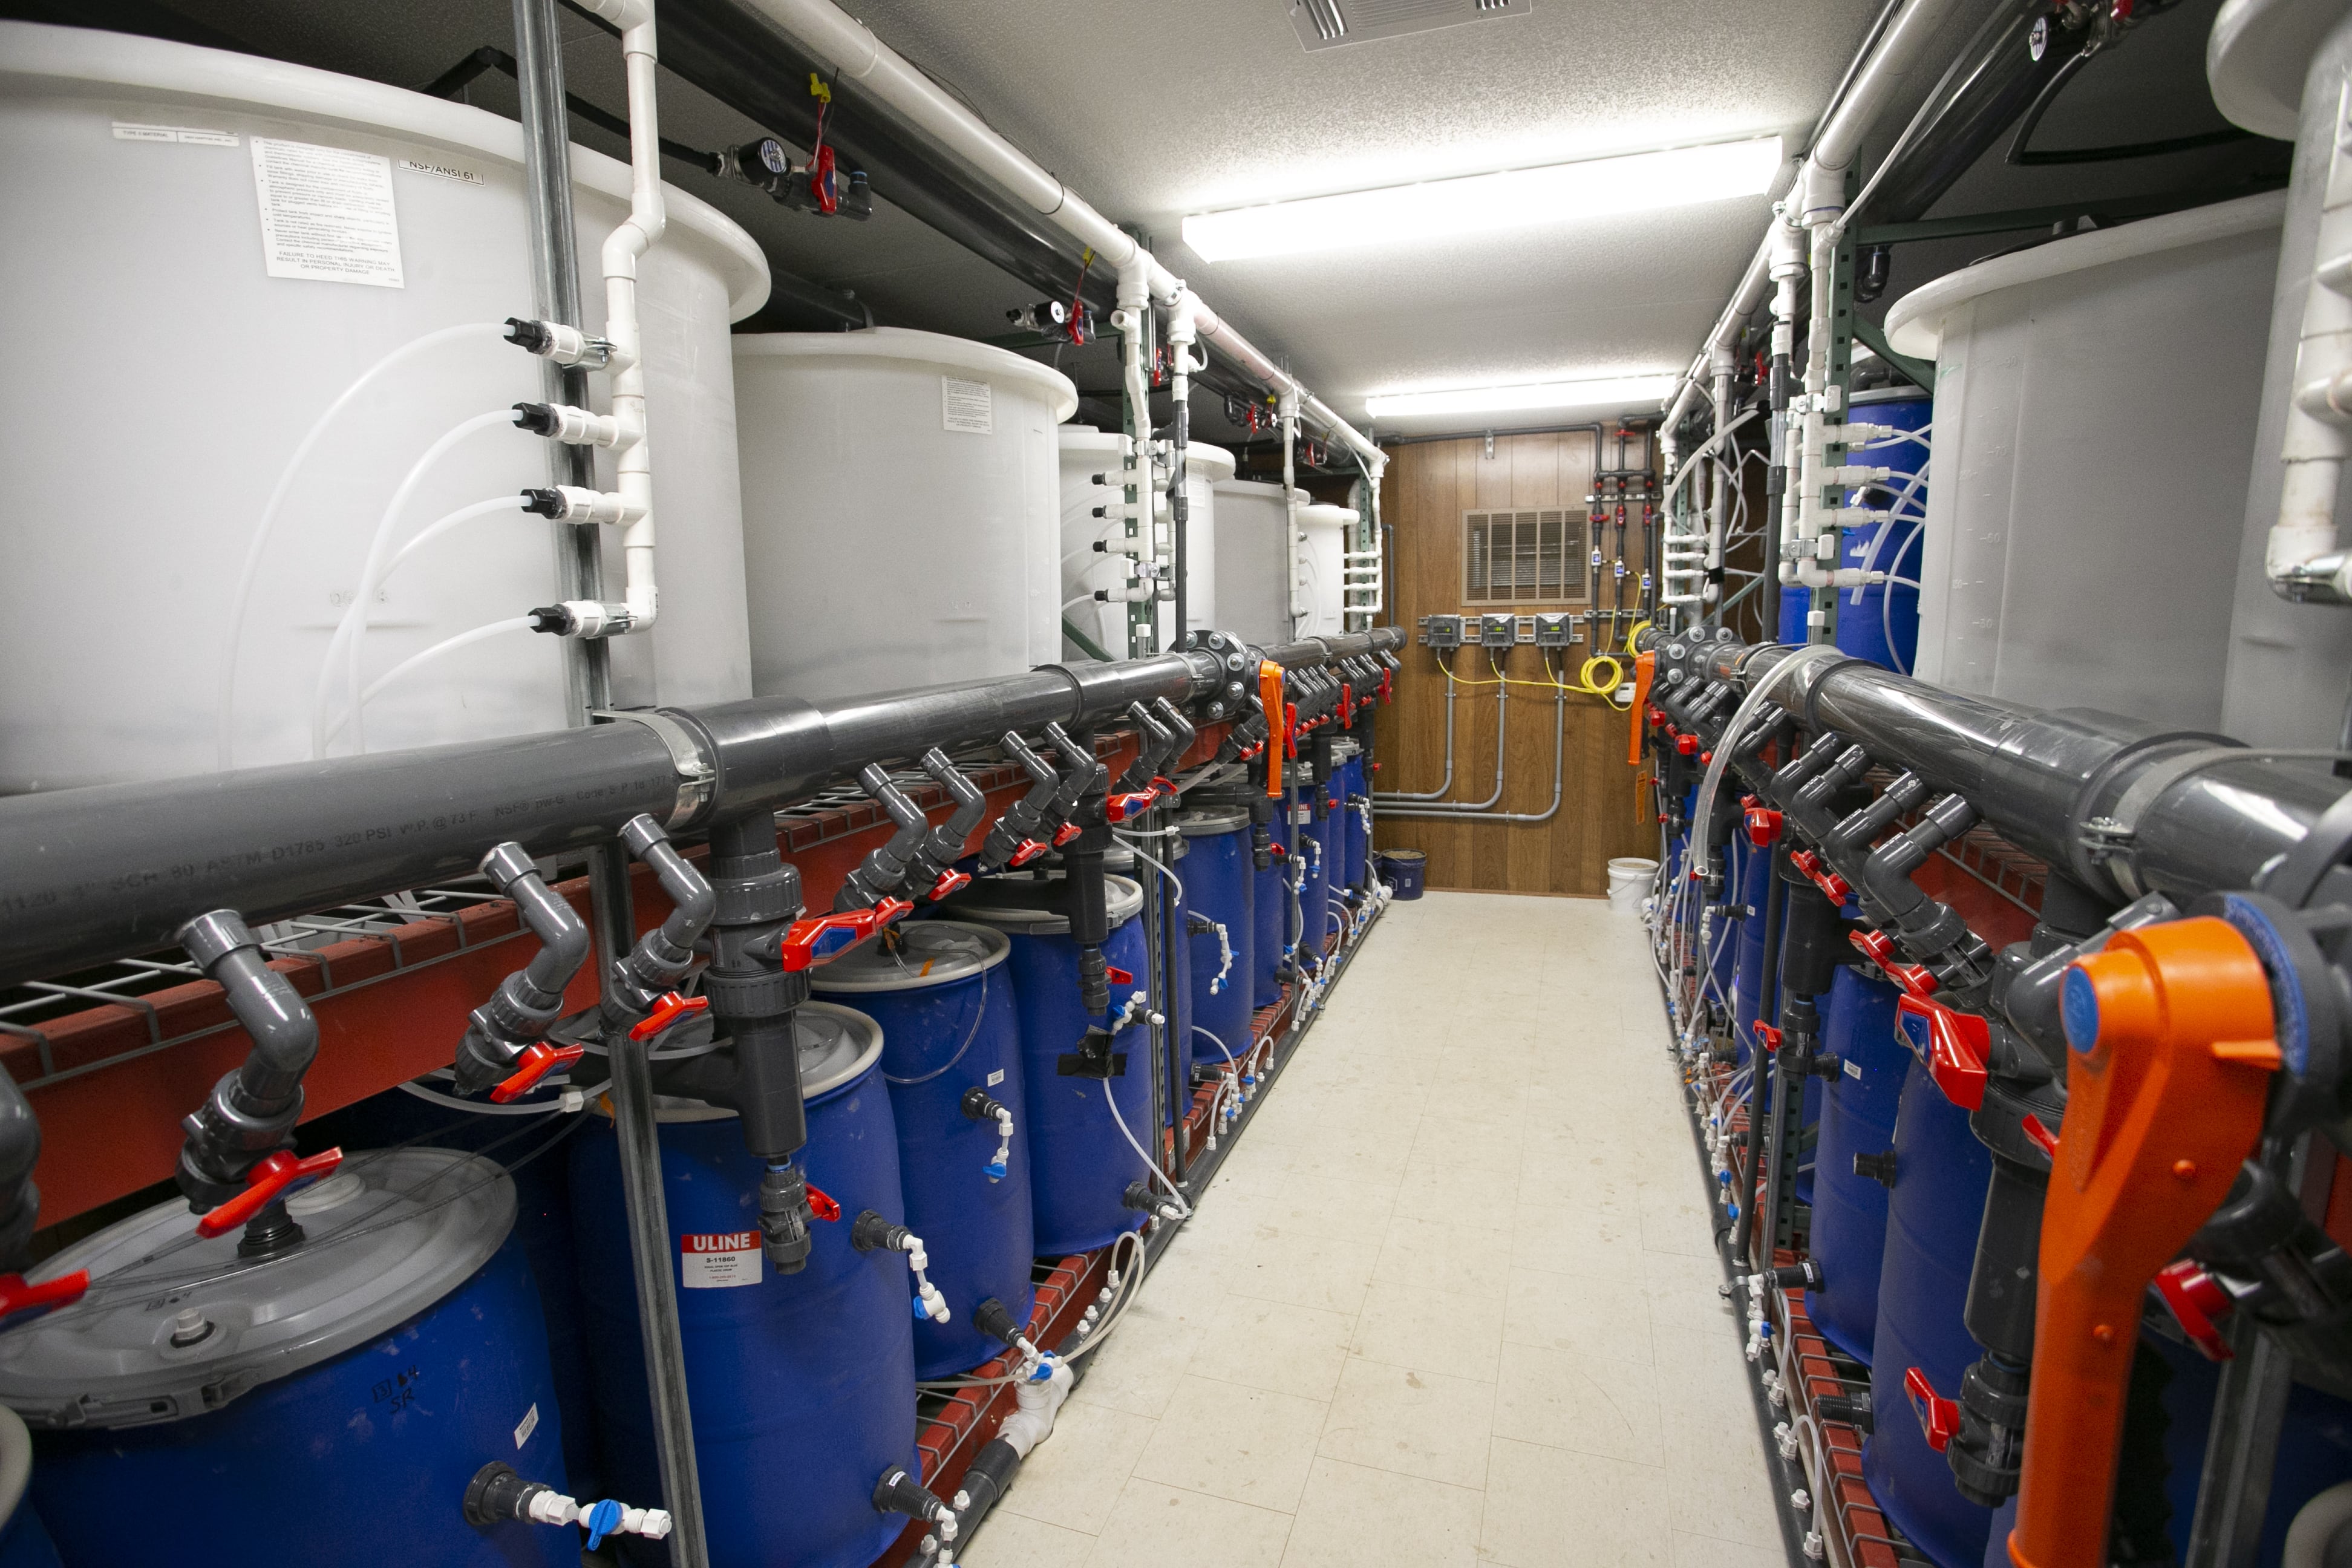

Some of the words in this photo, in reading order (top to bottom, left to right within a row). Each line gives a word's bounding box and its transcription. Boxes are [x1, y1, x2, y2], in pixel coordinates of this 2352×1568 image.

[410, 162, 460, 177] NSF/ANSI
[463, 172, 474, 180] 61
[271, 840, 325, 861] D1785
[333, 832, 362, 848] 320
[365, 827, 392, 842] PSI
[433, 815, 448, 831] @
[450, 813, 466, 825] 73
[693, 1232, 751, 1251] ULINE
